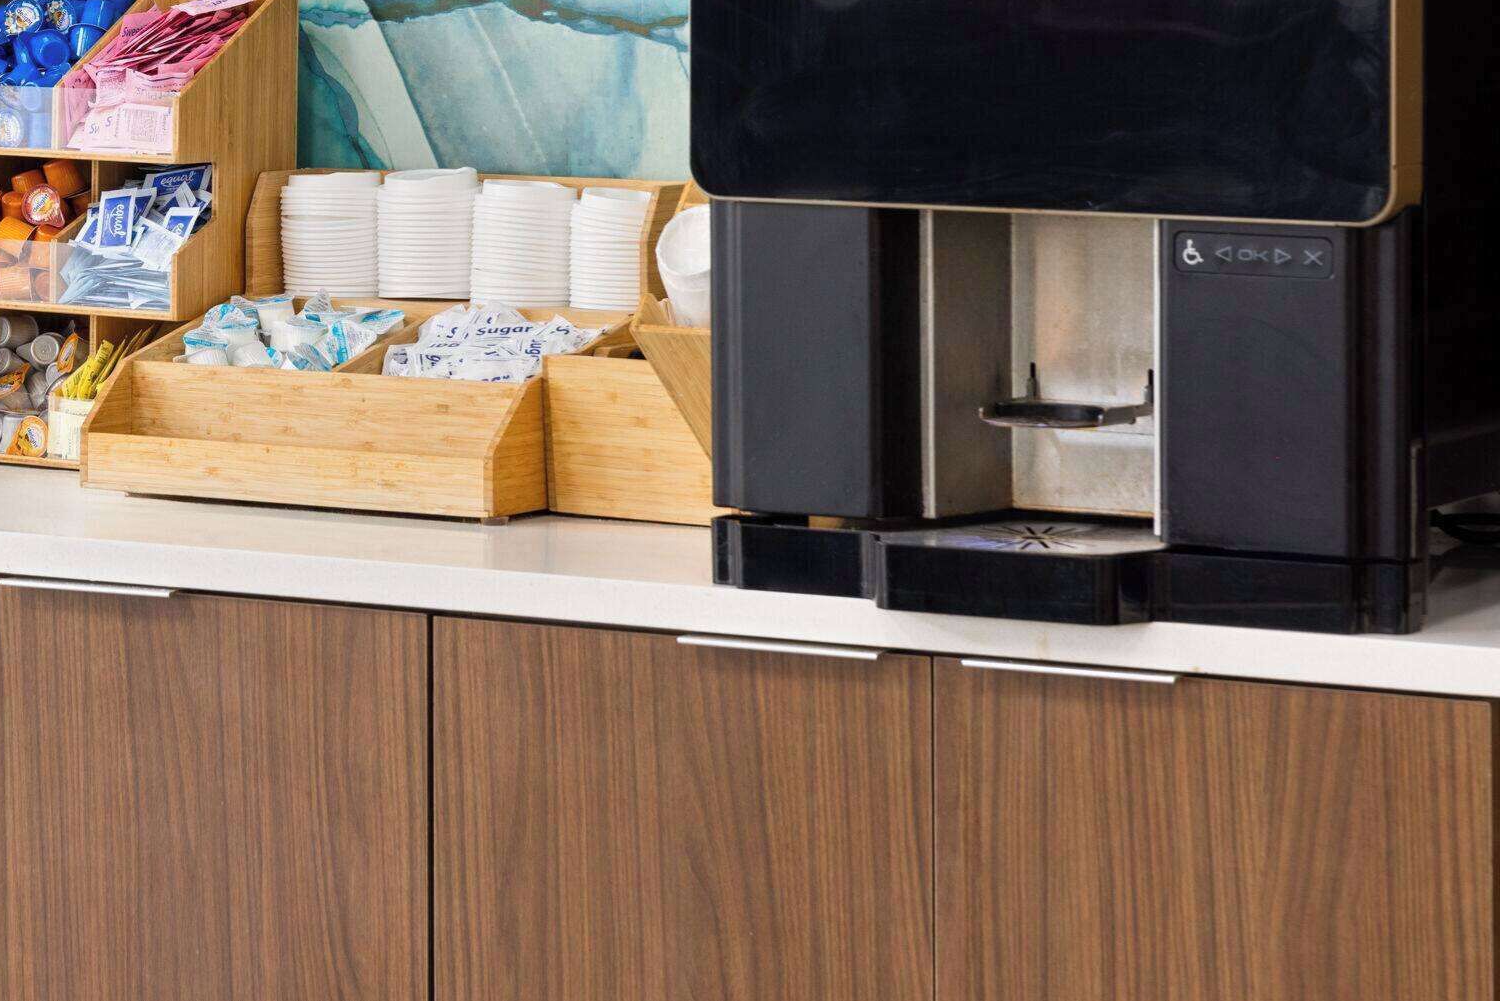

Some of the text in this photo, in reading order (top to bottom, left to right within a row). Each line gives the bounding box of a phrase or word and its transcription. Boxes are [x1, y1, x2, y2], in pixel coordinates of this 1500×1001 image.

[160, 170, 195, 187] equal
[111, 203, 126, 238] equal
[1238, 249, 1269, 261] OK
[476, 326, 534, 336] sugar
